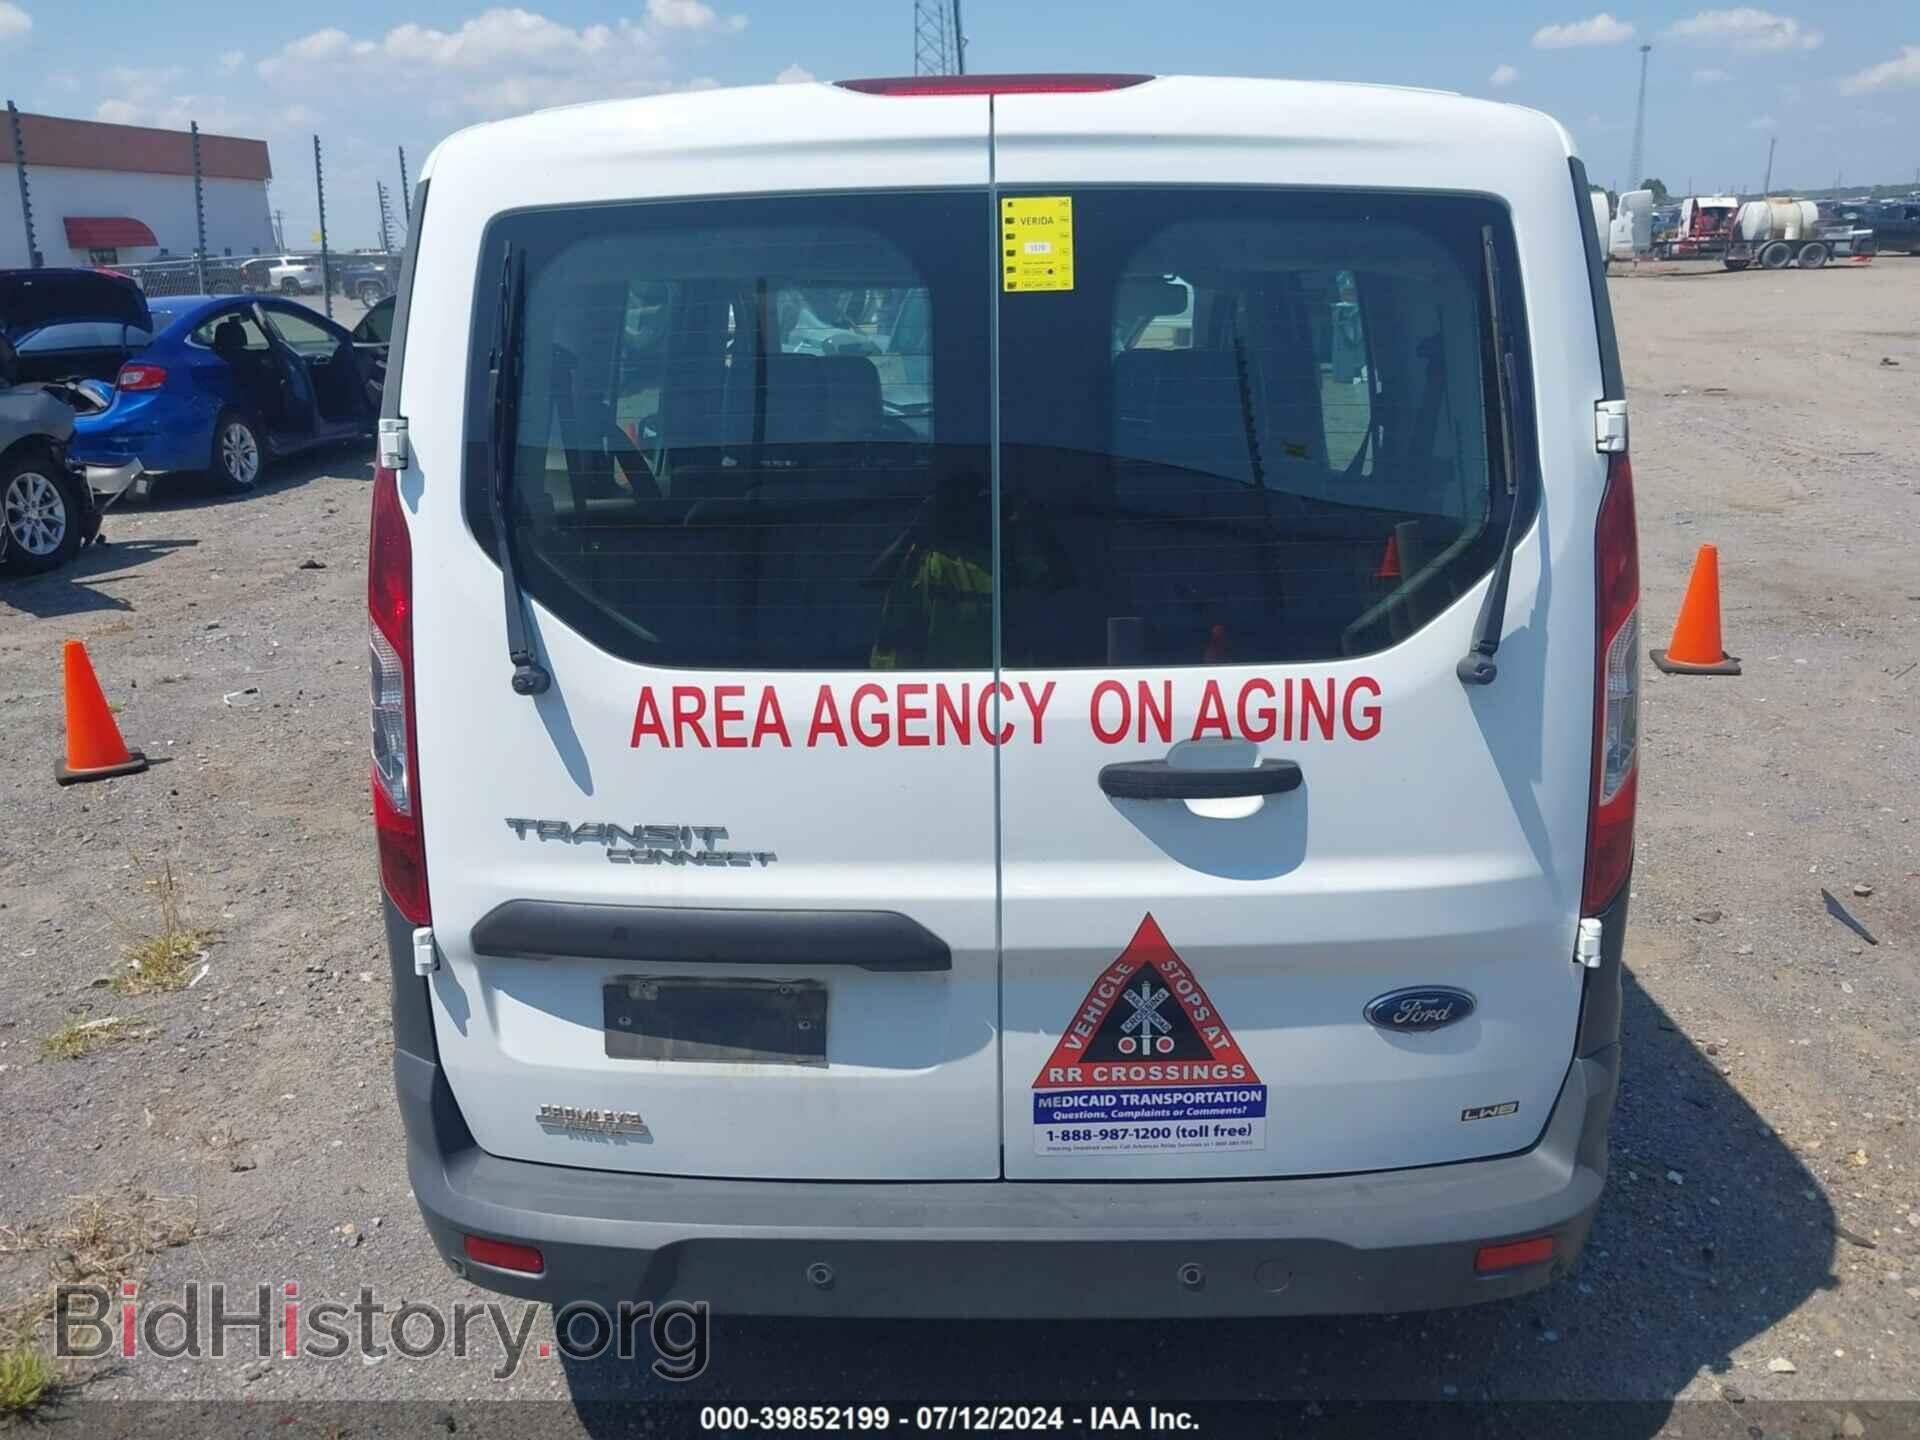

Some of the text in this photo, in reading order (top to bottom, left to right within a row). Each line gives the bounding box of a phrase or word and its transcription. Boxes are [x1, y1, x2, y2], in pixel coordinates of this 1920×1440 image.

[1020, 217, 1054, 225] VERIDA
[630, 676, 1382, 748] AREA AGENCY ON AGING
[504, 818, 729, 851] TRANSIT
[607, 848, 778, 868] CONNECT
[1064, 962, 1134, 1051] VEHICLE
[1160, 960, 1231, 1050] STOPS AT
[1393, 998, 1453, 1024] Ford
[1049, 1064, 1246, 1082] RR CROSSINGS
[1038, 1090, 1262, 1108] MEDICAID TRANSPORTATION
[1052, 1106, 1248, 1121] Questions, Complaints or Comments?
[1046, 1123, 1252, 1142] 1-888-987-1200 (toll free)
